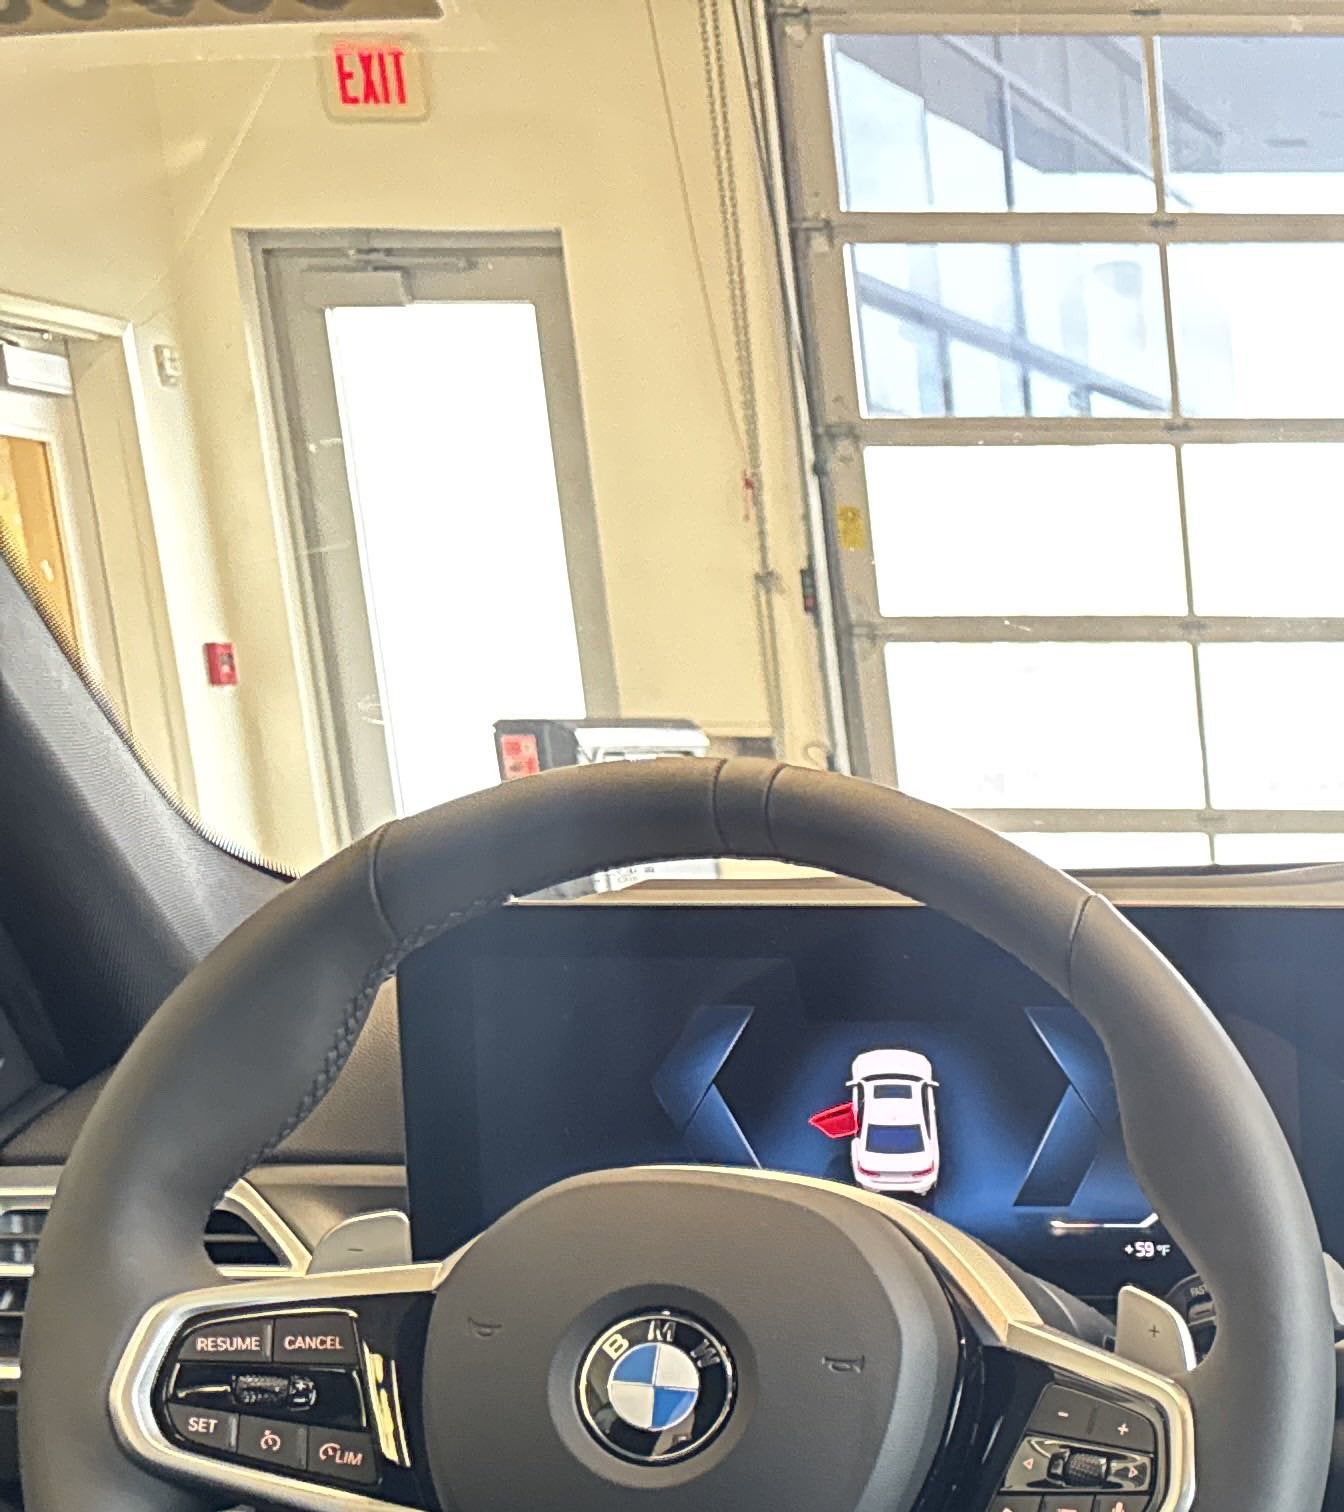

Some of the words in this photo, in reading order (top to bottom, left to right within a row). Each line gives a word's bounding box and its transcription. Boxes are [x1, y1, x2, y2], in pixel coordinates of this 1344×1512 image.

[334, 50, 408, 106] EXIT
[196, 1336, 261, 1351] RESUME
[283, 1335, 345, 1350] CANCEL
[602, 1319, 721, 1368] BMW
[187, 1416, 219, 1434] SET
[335, 1450, 363, 1467] LIM
